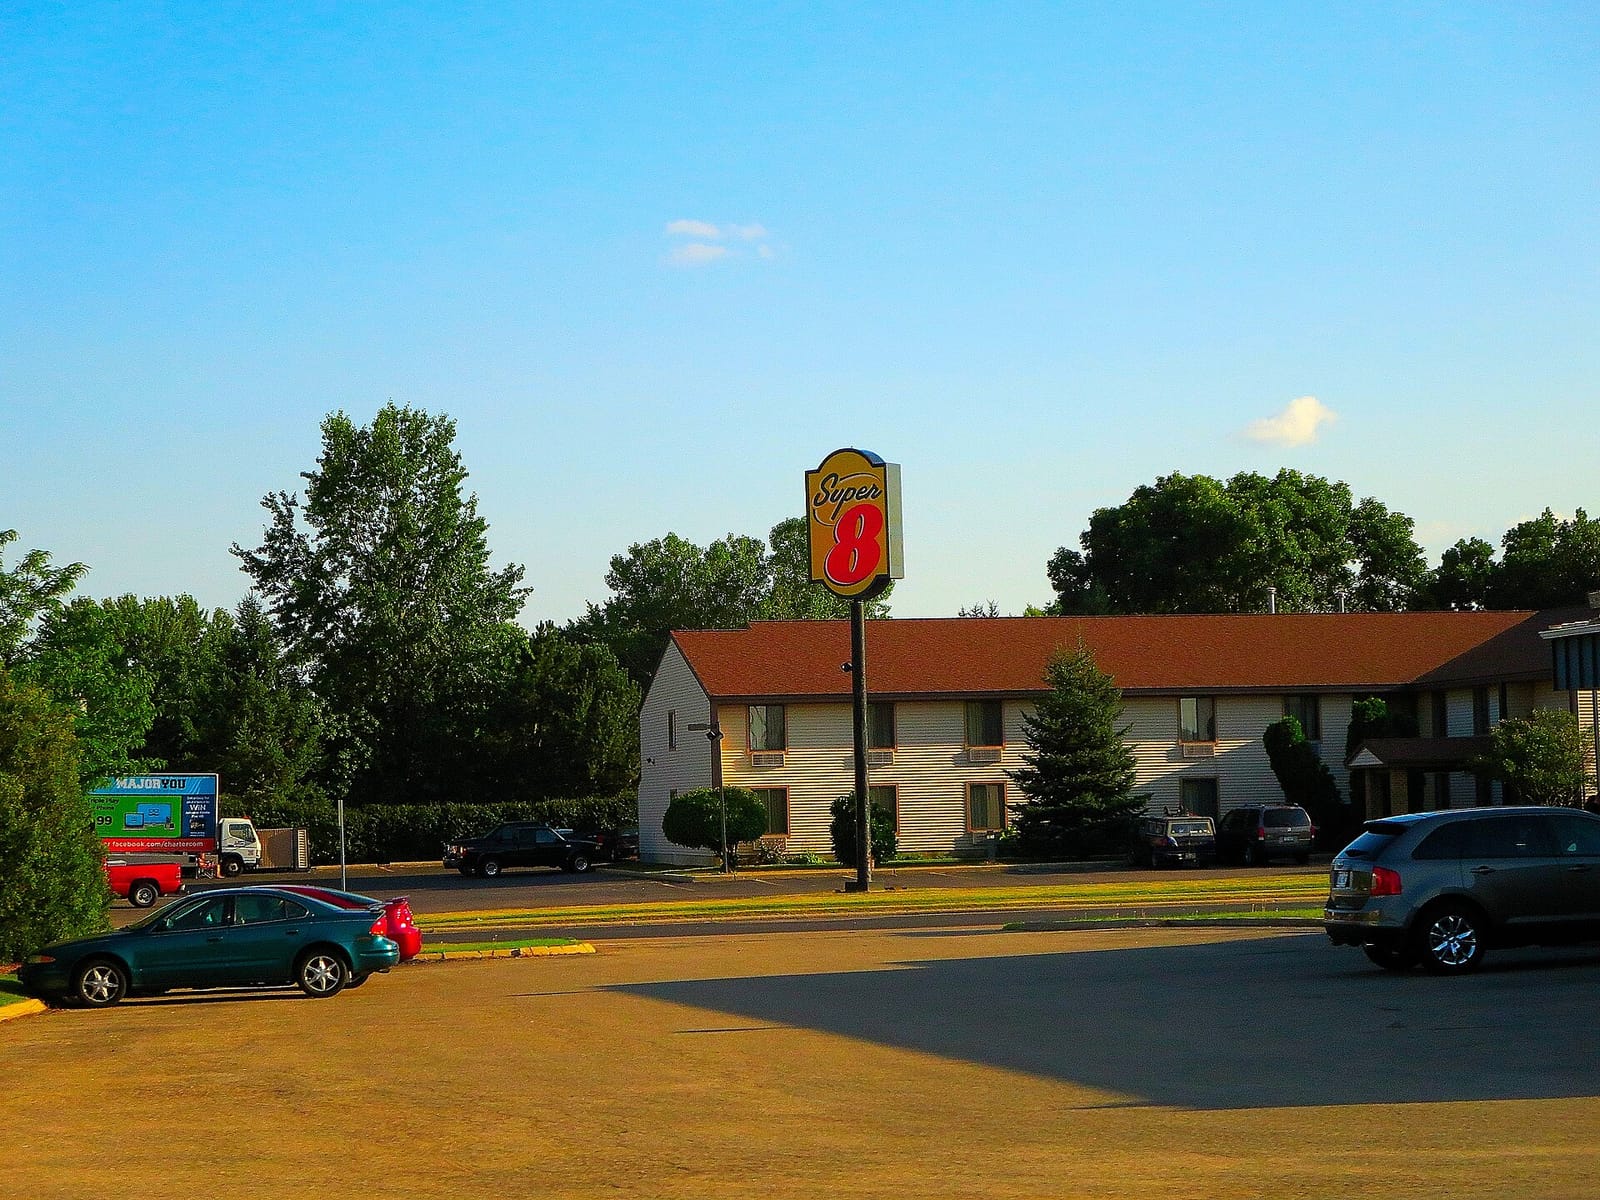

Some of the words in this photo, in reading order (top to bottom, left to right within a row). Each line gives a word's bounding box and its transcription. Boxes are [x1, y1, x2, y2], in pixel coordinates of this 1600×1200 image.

[813, 472, 883, 521] Super
[824, 503, 884, 586] 8
[96, 815, 113, 826] 99
